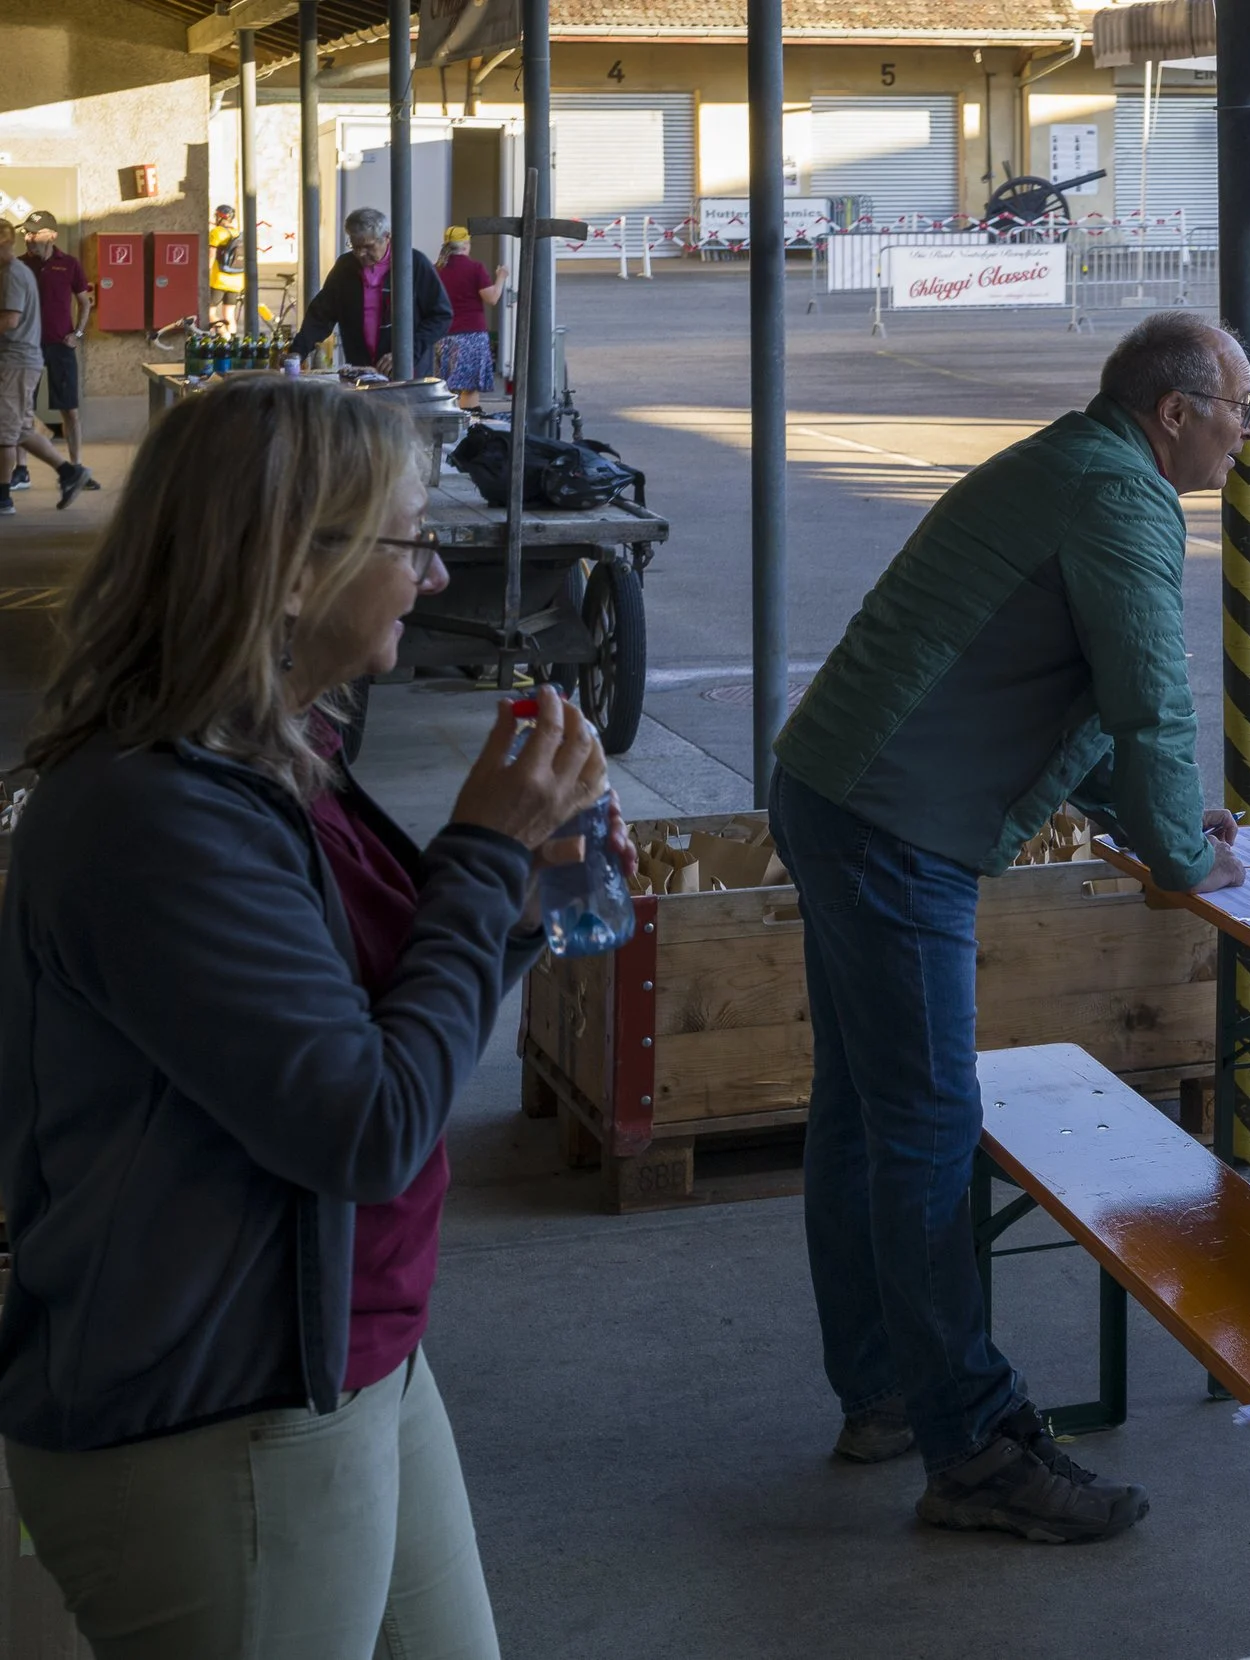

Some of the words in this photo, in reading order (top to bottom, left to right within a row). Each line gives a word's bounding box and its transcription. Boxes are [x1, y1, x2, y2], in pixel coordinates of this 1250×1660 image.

[607, 60, 625, 83] 4
[880, 63, 897, 87] 5
[909, 272, 973, 301] Chläggi
[977, 261, 1050, 288] Classic
